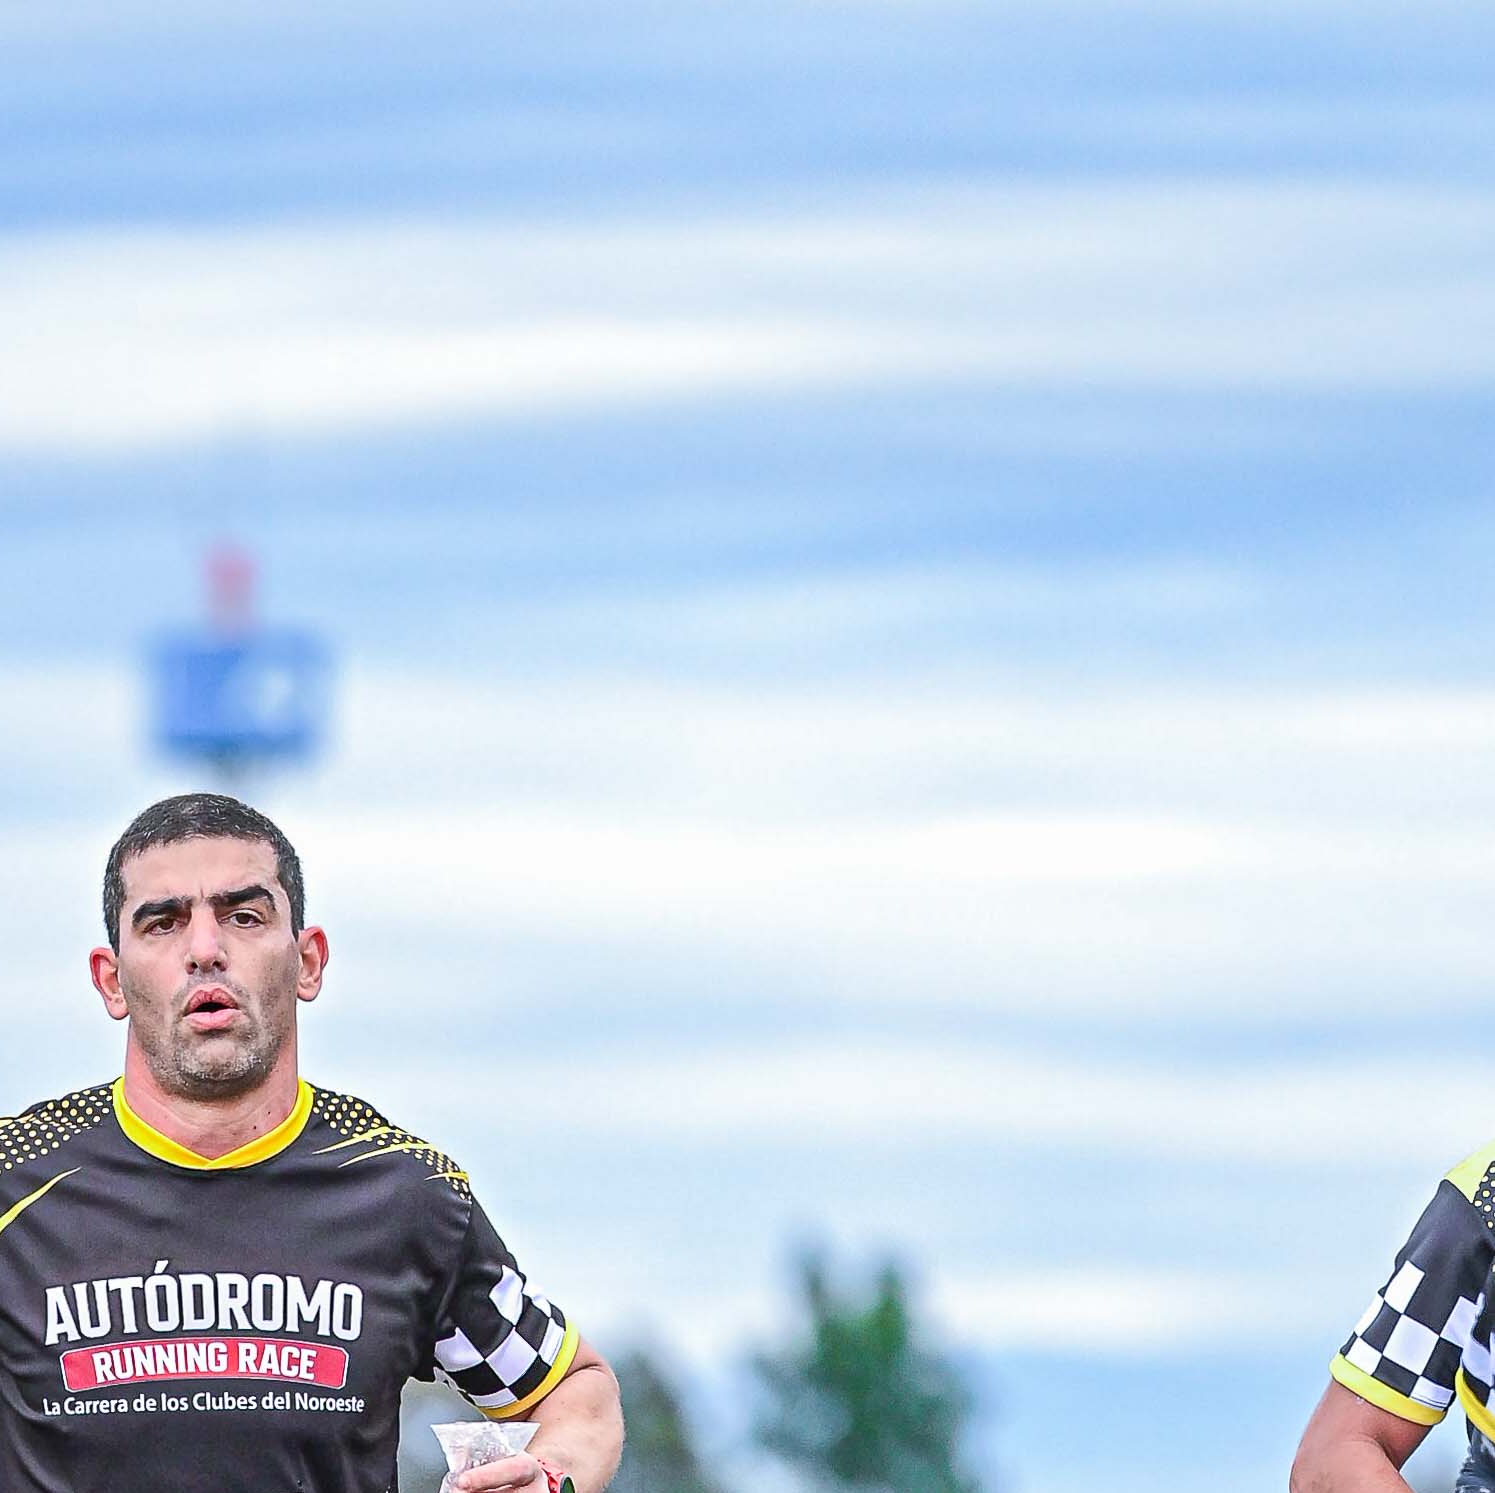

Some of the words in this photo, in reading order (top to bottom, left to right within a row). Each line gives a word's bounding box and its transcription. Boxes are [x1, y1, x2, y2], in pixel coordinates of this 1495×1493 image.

[43, 1259, 365, 1347] AUTÓDROMO
[91, 1342, 229, 1384] RUNNING
[237, 1342, 319, 1381] RACE
[42, 1398, 61, 1416] La
[64, 1397, 129, 1416] Carrera
[132, 1394, 156, 1413] de
[160, 1394, 189, 1412] los
[192, 1391, 258, 1412] Clubes
[261, 1391, 291, 1411] del
[294, 1393, 366, 1413] Noroeste
